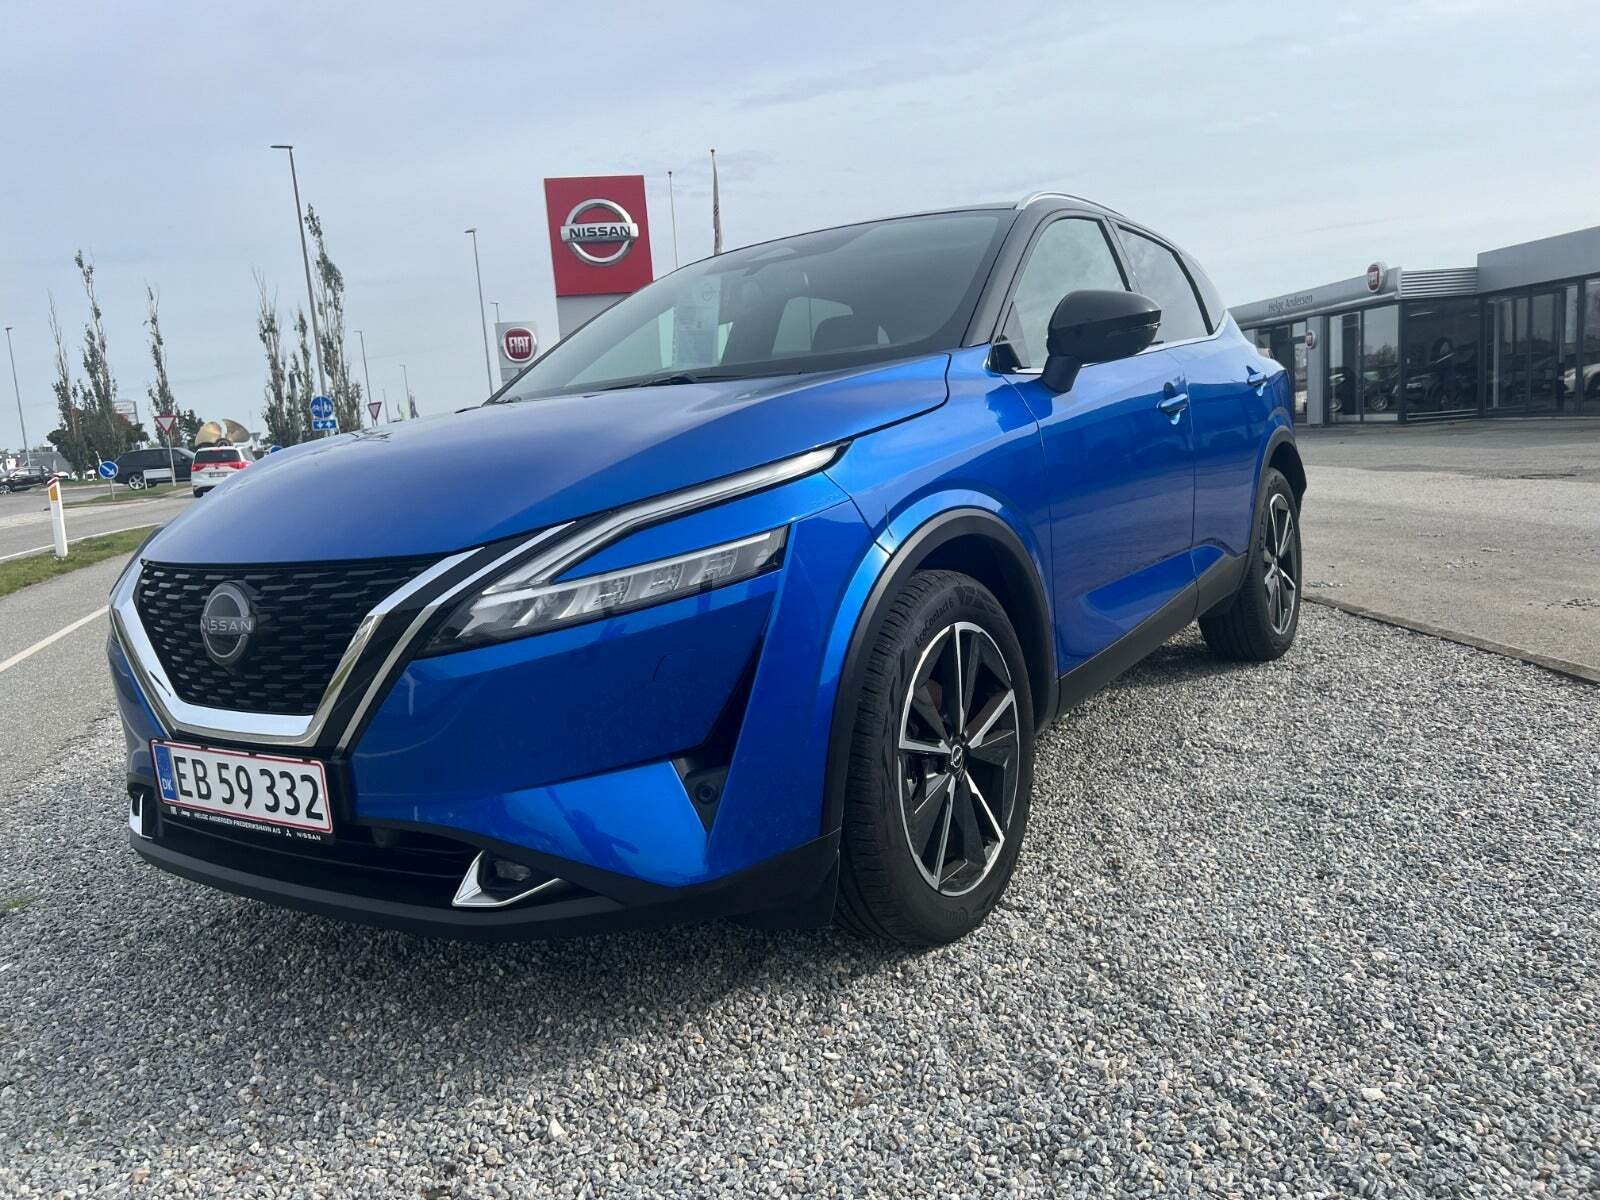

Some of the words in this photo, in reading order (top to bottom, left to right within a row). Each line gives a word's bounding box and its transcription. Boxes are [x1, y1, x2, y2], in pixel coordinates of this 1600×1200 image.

[569, 226, 631, 239] NISSAN
[508, 336, 530, 353] FIAT
[200, 619, 252, 631] NISSAN
[162, 778, 172, 791] DK
[174, 756, 211, 800] EB
[217, 762, 253, 809] 59
[259, 768, 324, 821] 332
[208, 815, 233, 825] ANDERSEN
[233, 819, 272, 833] FREDERIKSHAVN
[296, 832, 321, 841] NISSAN
